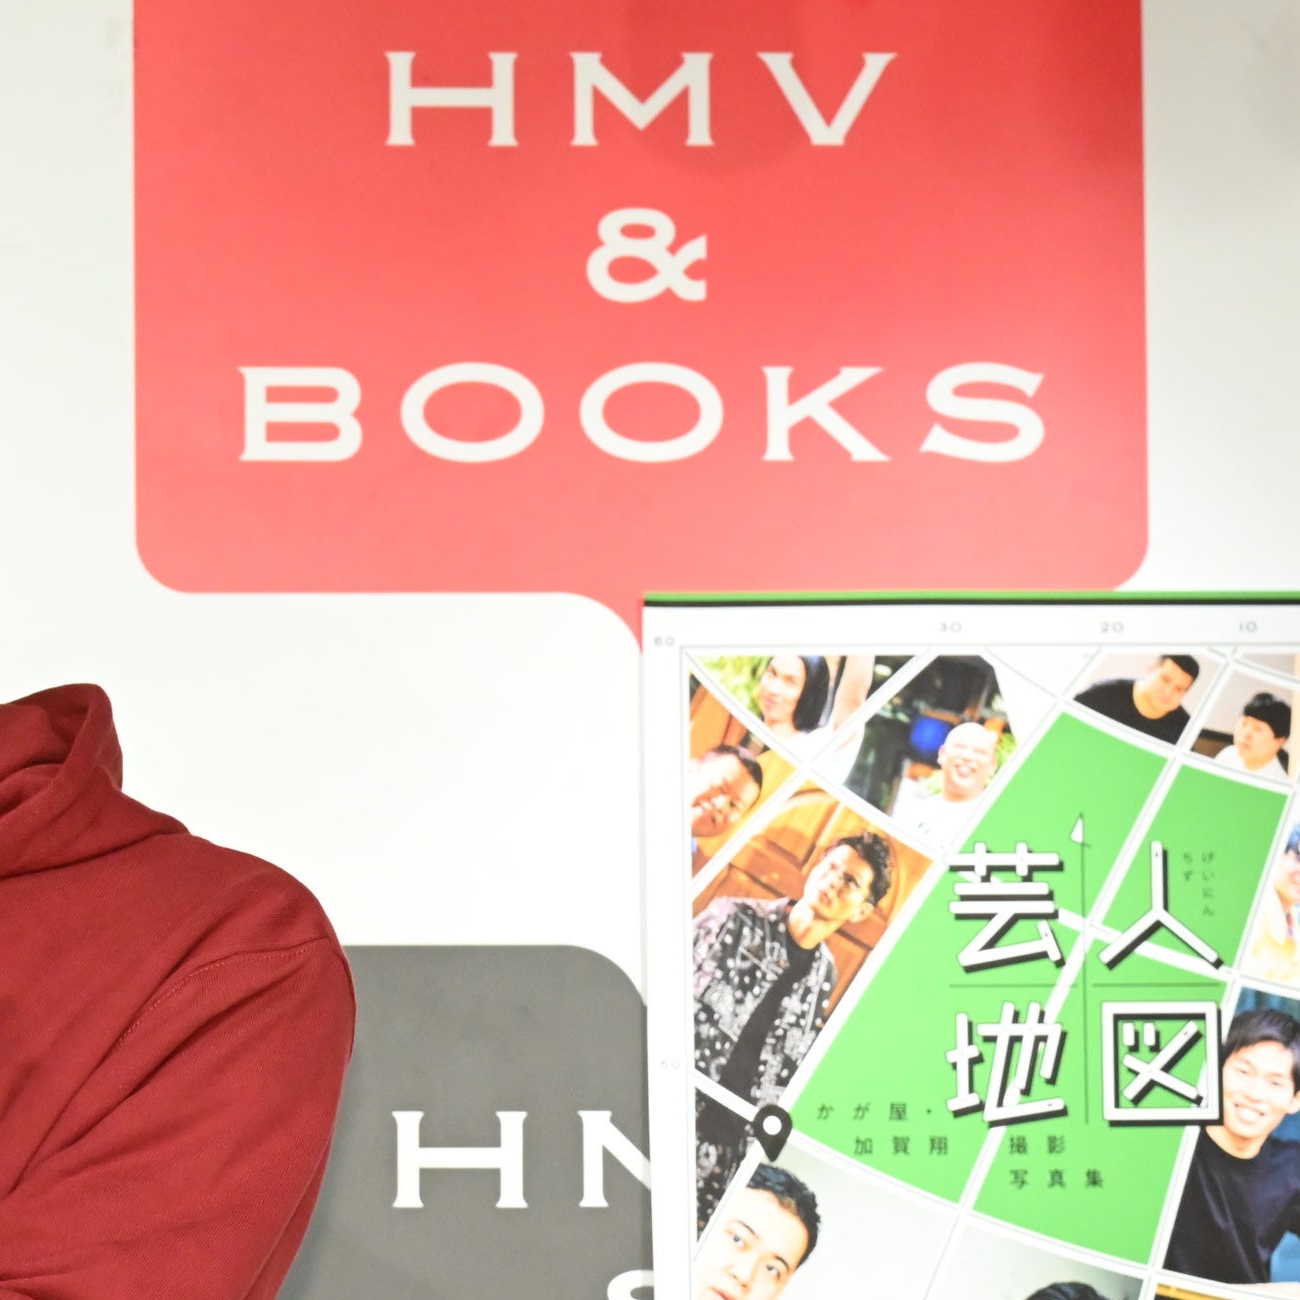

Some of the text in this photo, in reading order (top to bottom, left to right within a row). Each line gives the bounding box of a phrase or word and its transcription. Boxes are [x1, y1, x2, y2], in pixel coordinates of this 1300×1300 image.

[386, 52, 898, 146] HMV
[586, 208, 708, 303] &
[238, 361, 1046, 463] BOOKS
[1238, 620, 1259, 634] 10
[943, 841, 1224, 973] 芸人
[946, 1001, 1226, 1127] 地図
[1009, 1134, 1067, 1155] 撮影
[1009, 1168, 1105, 1189] 写真集
